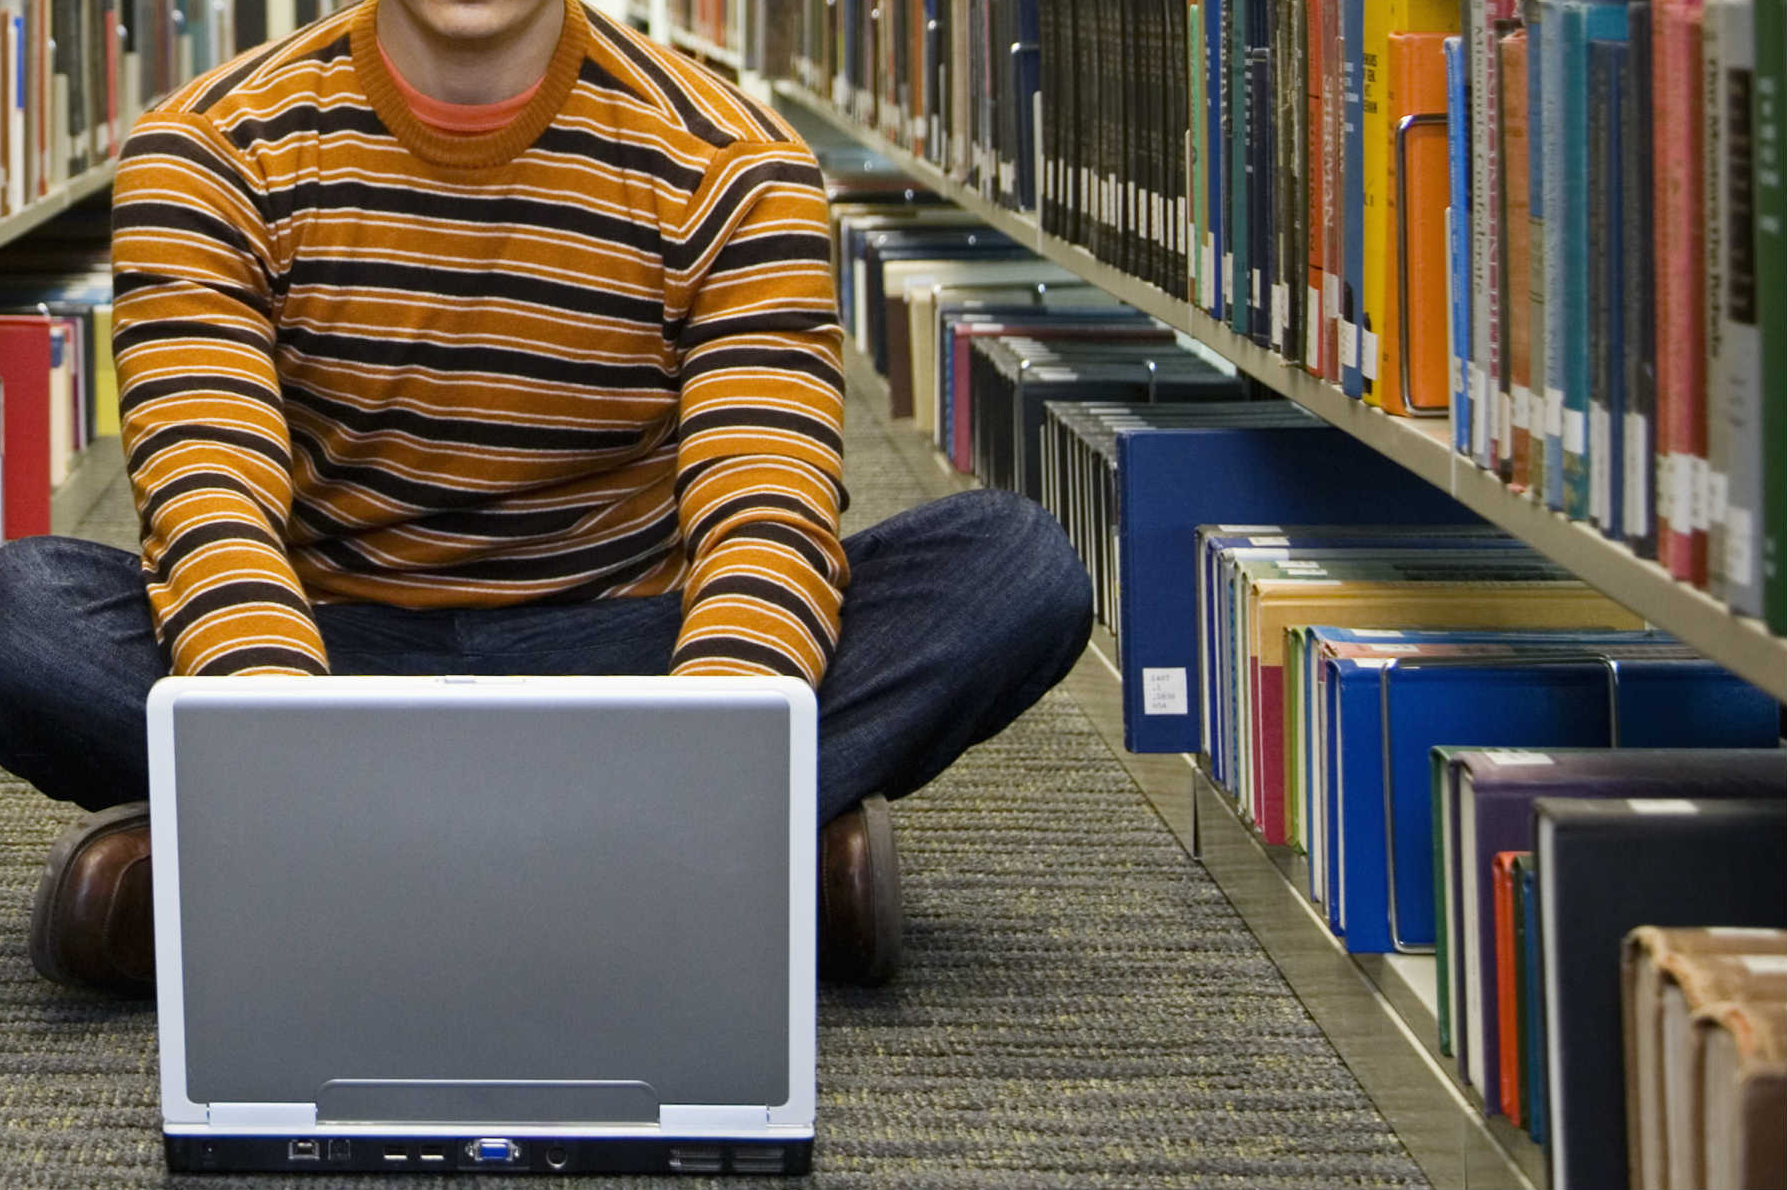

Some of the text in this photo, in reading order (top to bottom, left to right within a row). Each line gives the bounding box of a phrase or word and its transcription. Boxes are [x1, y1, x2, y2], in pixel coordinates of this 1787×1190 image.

[1323, 73, 1334, 227] SHERMAN
[1474, 24, 1486, 295] Missouri's Confederate
